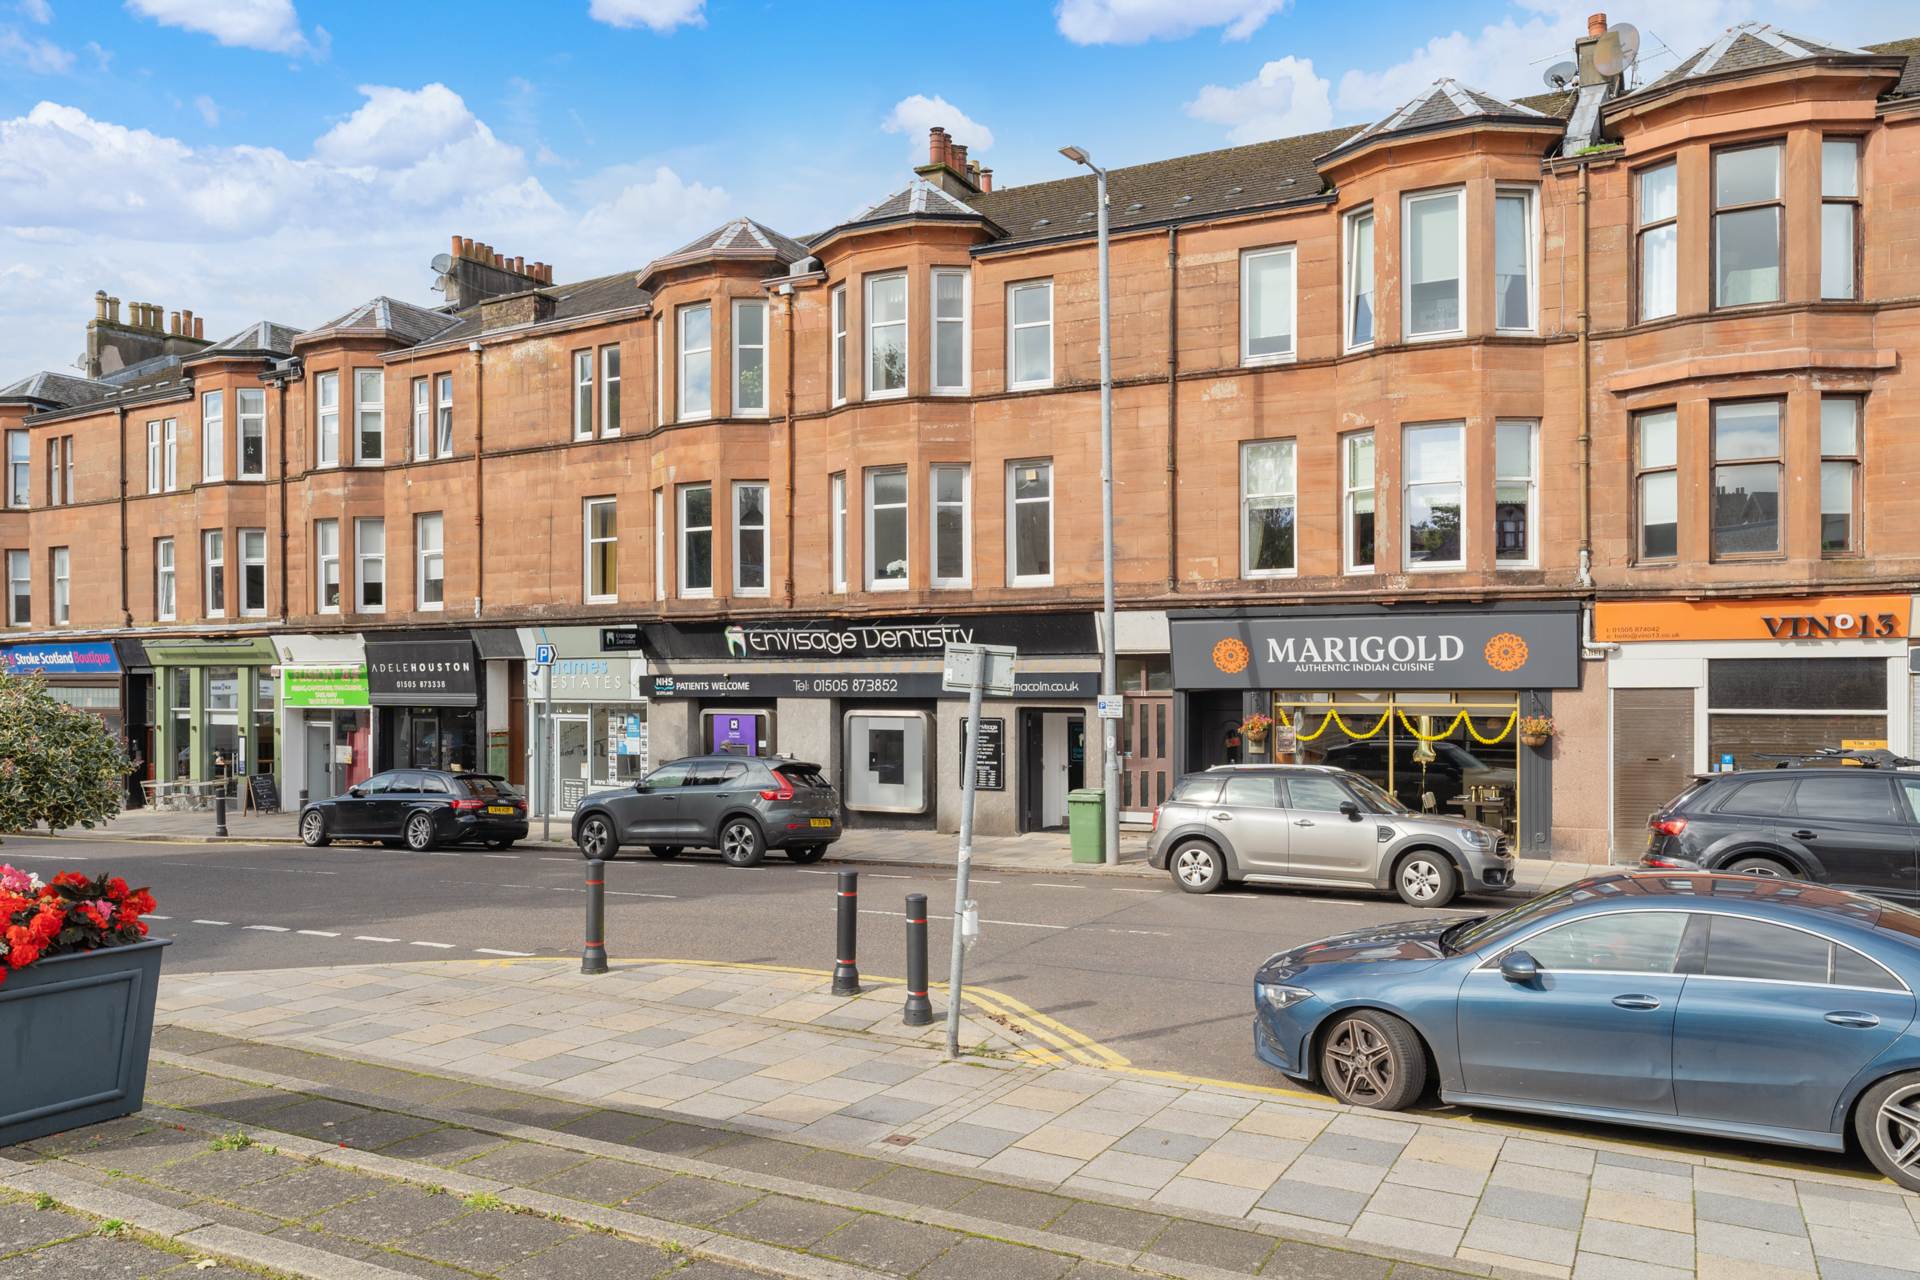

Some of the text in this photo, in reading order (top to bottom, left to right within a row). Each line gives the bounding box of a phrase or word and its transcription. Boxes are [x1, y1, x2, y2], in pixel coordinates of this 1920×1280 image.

[1266, 635, 1465, 663] MARIGOLD
[15, 652, 40, 665] Stroke
[40, 651, 73, 664] Scotland
[73, 651, 110, 667] Boutique
[1294, 662, 1435, 673] AUTHENTIC INDIAN CUISINE
[396, 680, 417, 689] 01505
[551, 676, 622, 689] ESTATES
[655, 677, 674, 686] NHS
[676, 681, 750, 691] PATIENTS WELCOME
[813, 679, 849, 692] 01505
[852, 679, 898, 692] 873852
